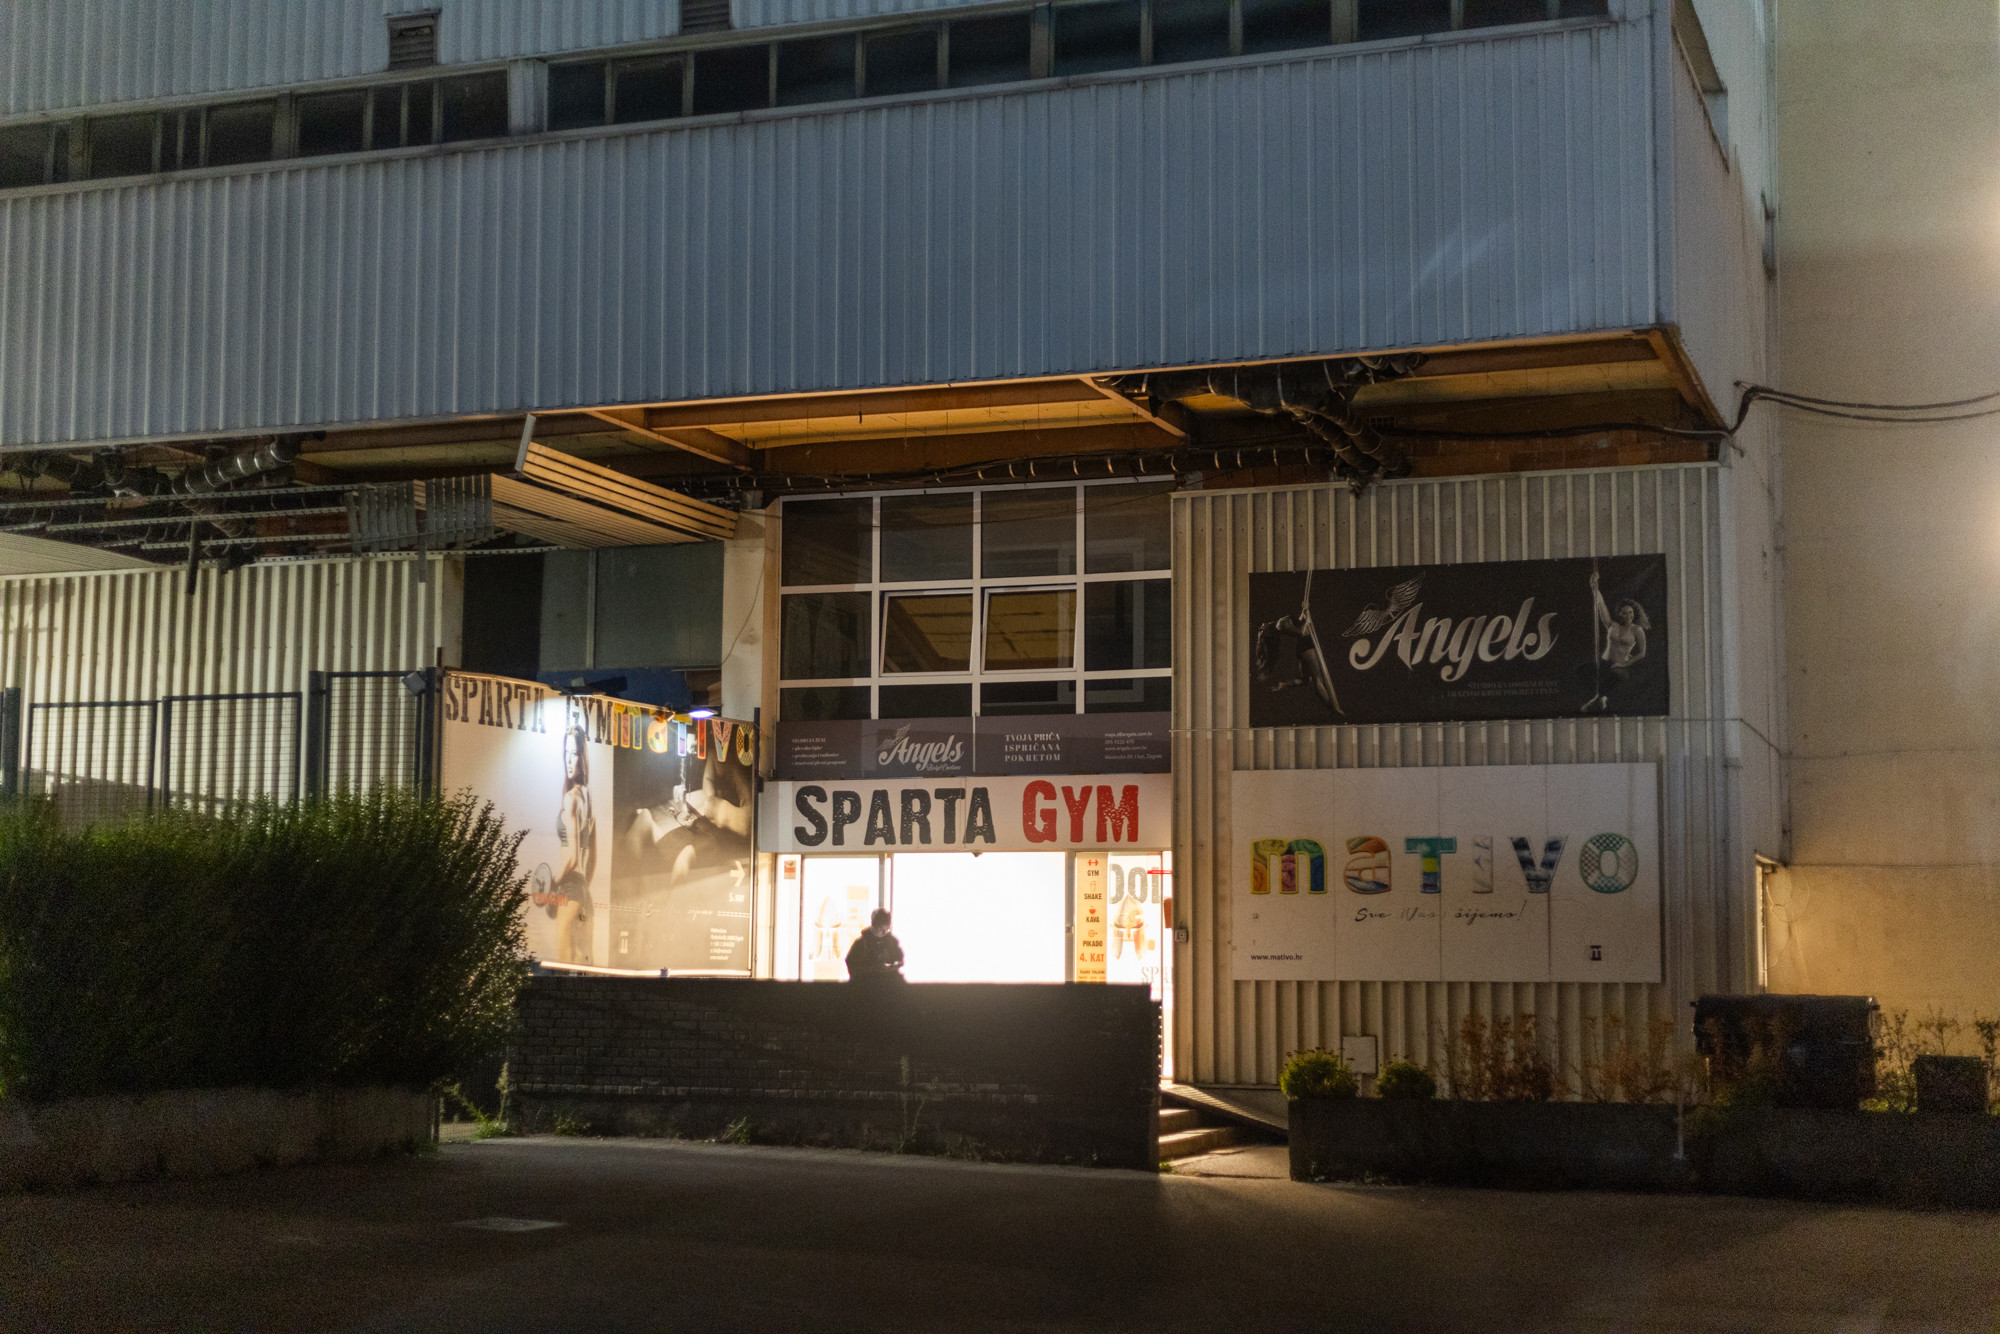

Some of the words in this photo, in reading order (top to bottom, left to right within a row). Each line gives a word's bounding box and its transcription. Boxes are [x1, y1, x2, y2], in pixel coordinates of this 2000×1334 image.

[1348, 597, 1559, 682] Angels
[446, 676, 547, 734] SPARTA
[1004, 734, 1032, 742] TVOJA
[1034, 731, 1061, 741] PRIČA
[1004, 742, 1061, 752] ISPRIČANA
[878, 735, 964, 771] Angels
[1004, 753, 1061, 762] POKRETOM
[795, 785, 996, 846] SPARTA
[1022, 780, 1139, 843] GYM
[1087, 869, 1100, 877] GYM
[1080, 952, 1088, 962] 4.
[1090, 952, 1105, 962] KAT
[1250, 953, 1303, 961] www.mativo.hr
